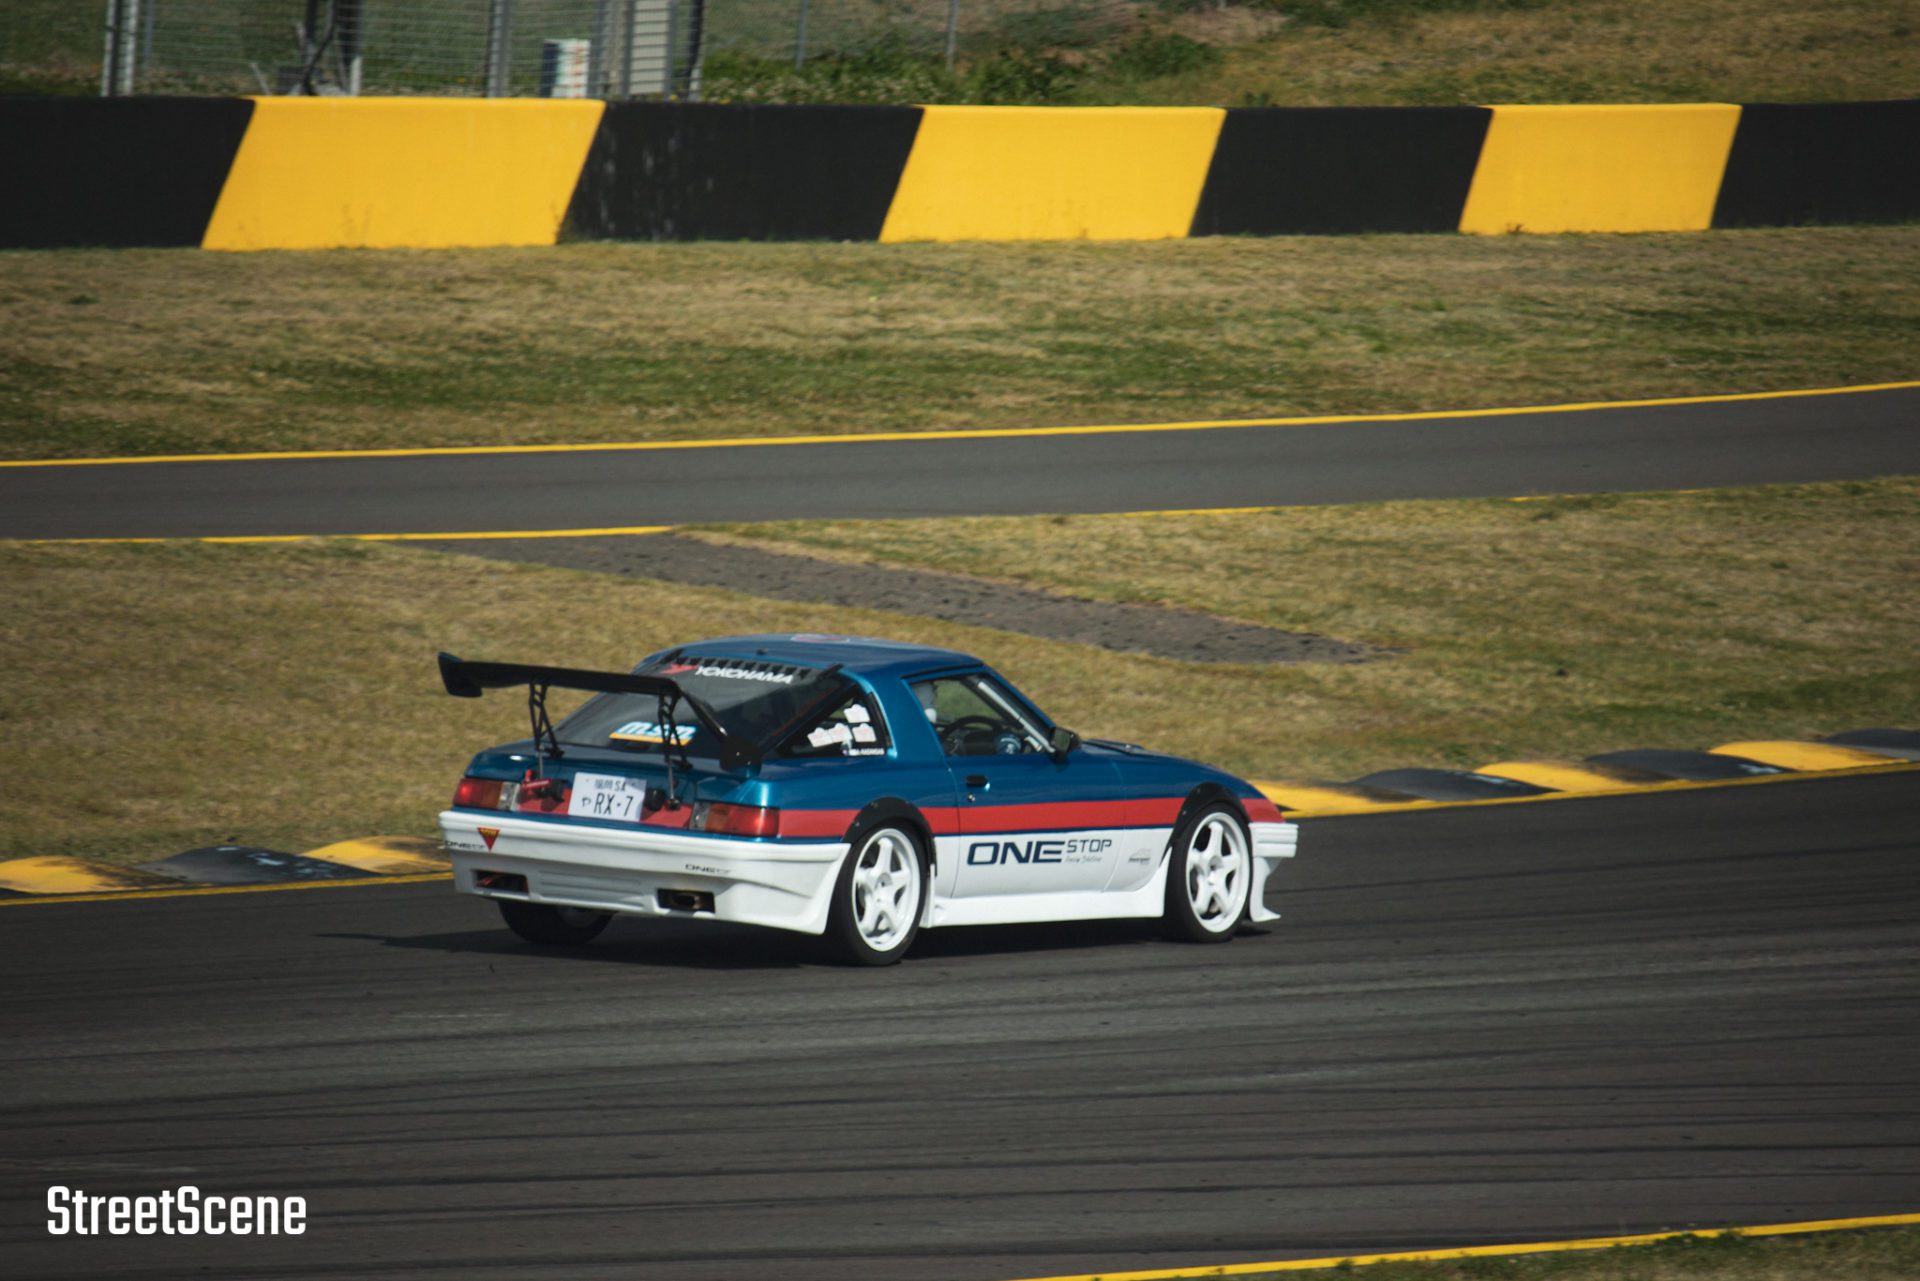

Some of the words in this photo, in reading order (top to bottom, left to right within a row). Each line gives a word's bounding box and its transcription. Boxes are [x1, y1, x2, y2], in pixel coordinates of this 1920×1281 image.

[695, 665, 793, 684] YOKOHAMA
[967, 841, 1065, 866] ONE
[1066, 839, 1113, 854] STOP
